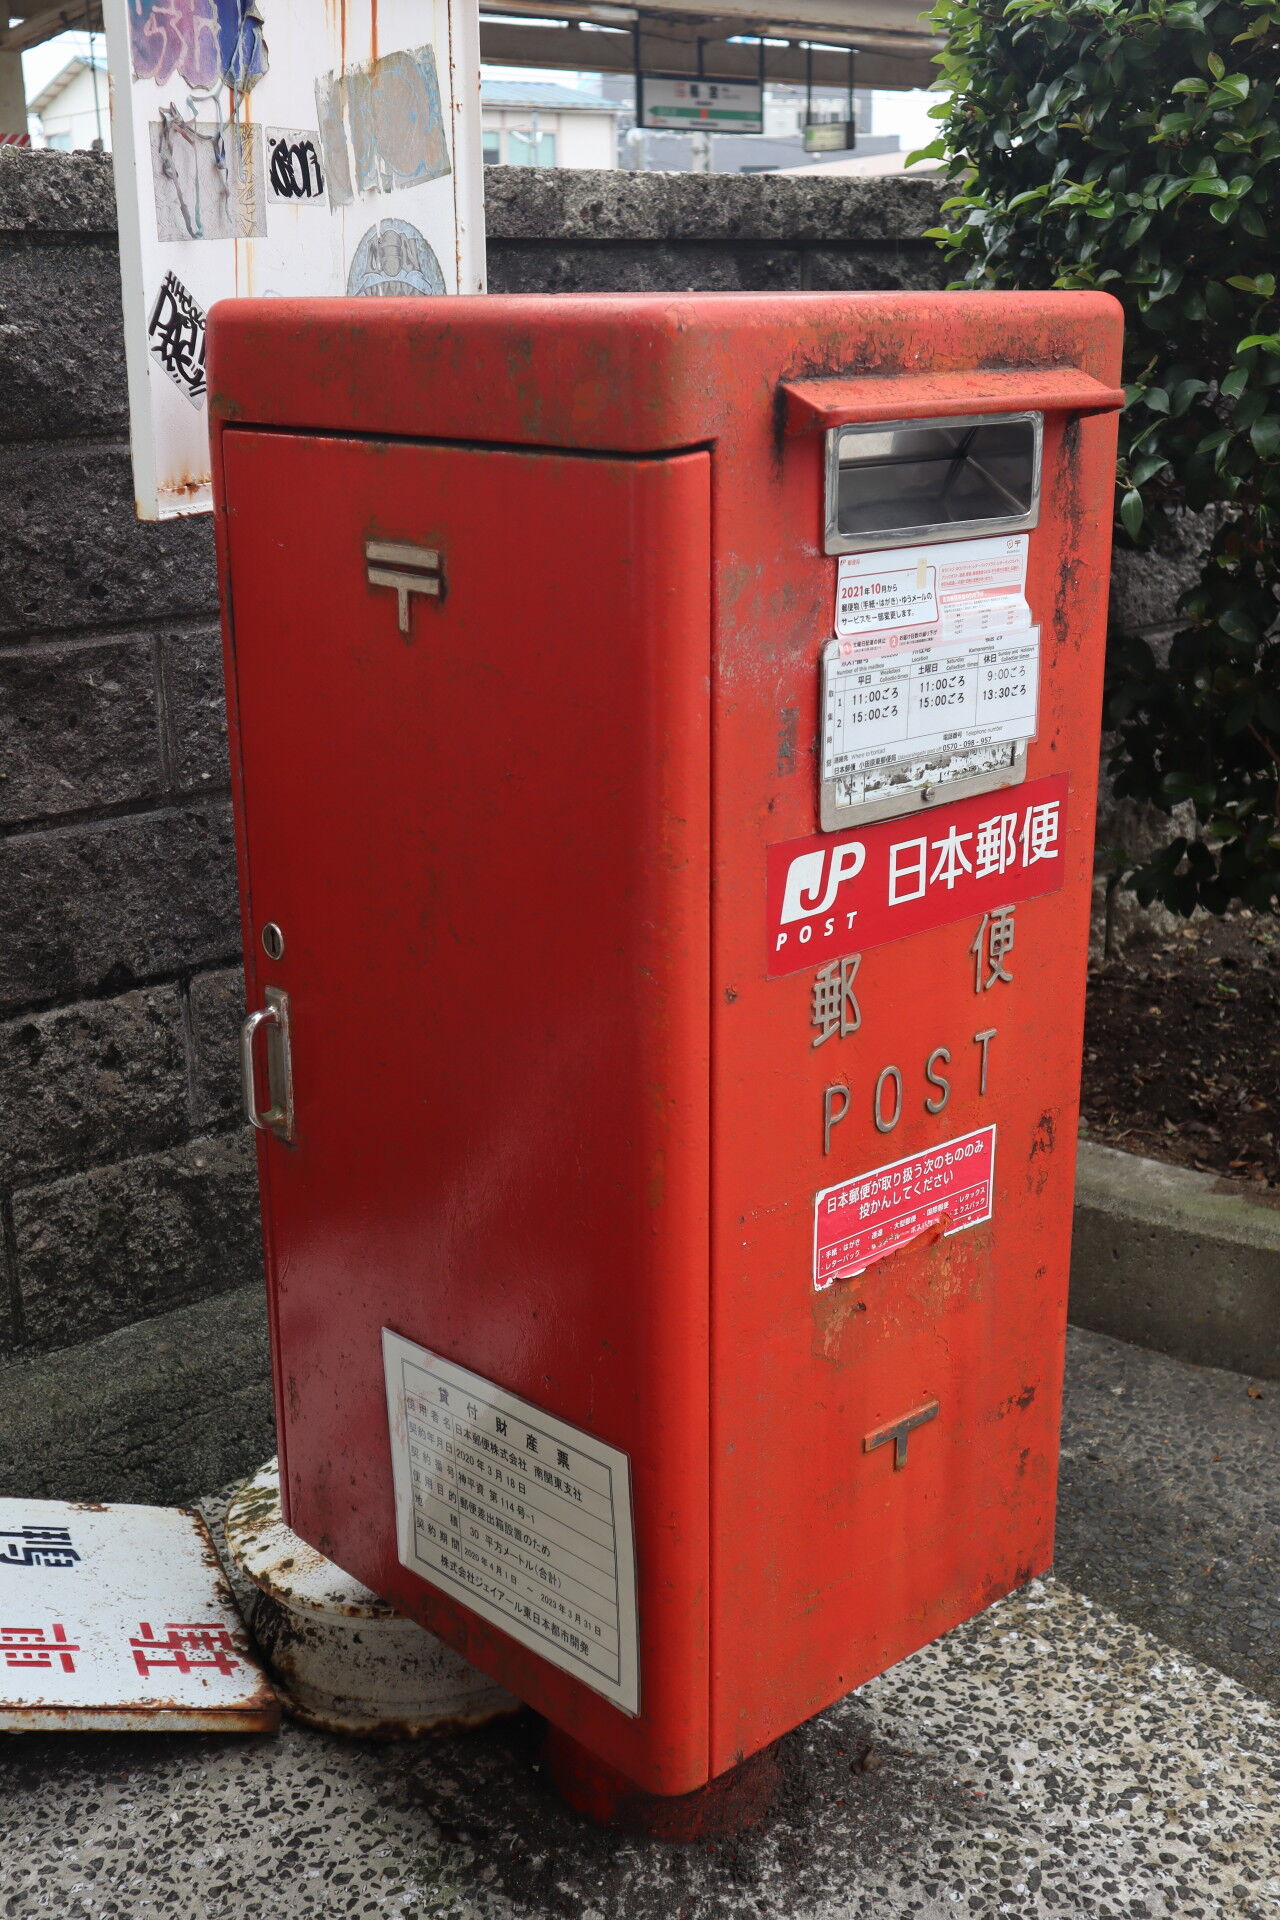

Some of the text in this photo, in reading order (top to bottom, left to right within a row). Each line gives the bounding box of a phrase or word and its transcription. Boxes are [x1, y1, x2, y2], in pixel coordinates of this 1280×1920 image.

[841, 583, 898, 599] 2021年10月から
[917, 663, 939, 675] 土曜日
[983, 654, 997, 664] 休日
[857, 675, 872, 686] 平日
[920, 675, 966, 694] 11:00ごろ
[987, 665, 1026, 682] 9:00ごろ
[852, 687, 899, 706] 11:00ごろ
[919, 692, 965, 709] 15:00ごろ
[983, 684, 1027, 701] 13:30ごろ
[852, 705, 898, 724] 15:00ごろ
[887, 800, 1060, 907] 日本郵便
[774, 911, 858, 952] POST
[823, 1028, 998, 1155] POST
[826, 1139, 984, 1215] 日本郵便が取り扱う次のもののみ
[858, 1169, 955, 1221] 投かんしてください
[406, 1396, 583, 1503] 使用者名 日本郵便株式会社 南関東支社
[408, 1420, 453, 1455] 契約年月日
[410, 1444, 455, 1479] 契約番号
[416, 1516, 460, 1553] 契約期間
[459, 1496, 551, 1558] 郵便差出箱設置のため
[469, 1526, 480, 1540] 30
[440, 1554, 590, 1657] 株式会社ジェイアール東日本都市開発
